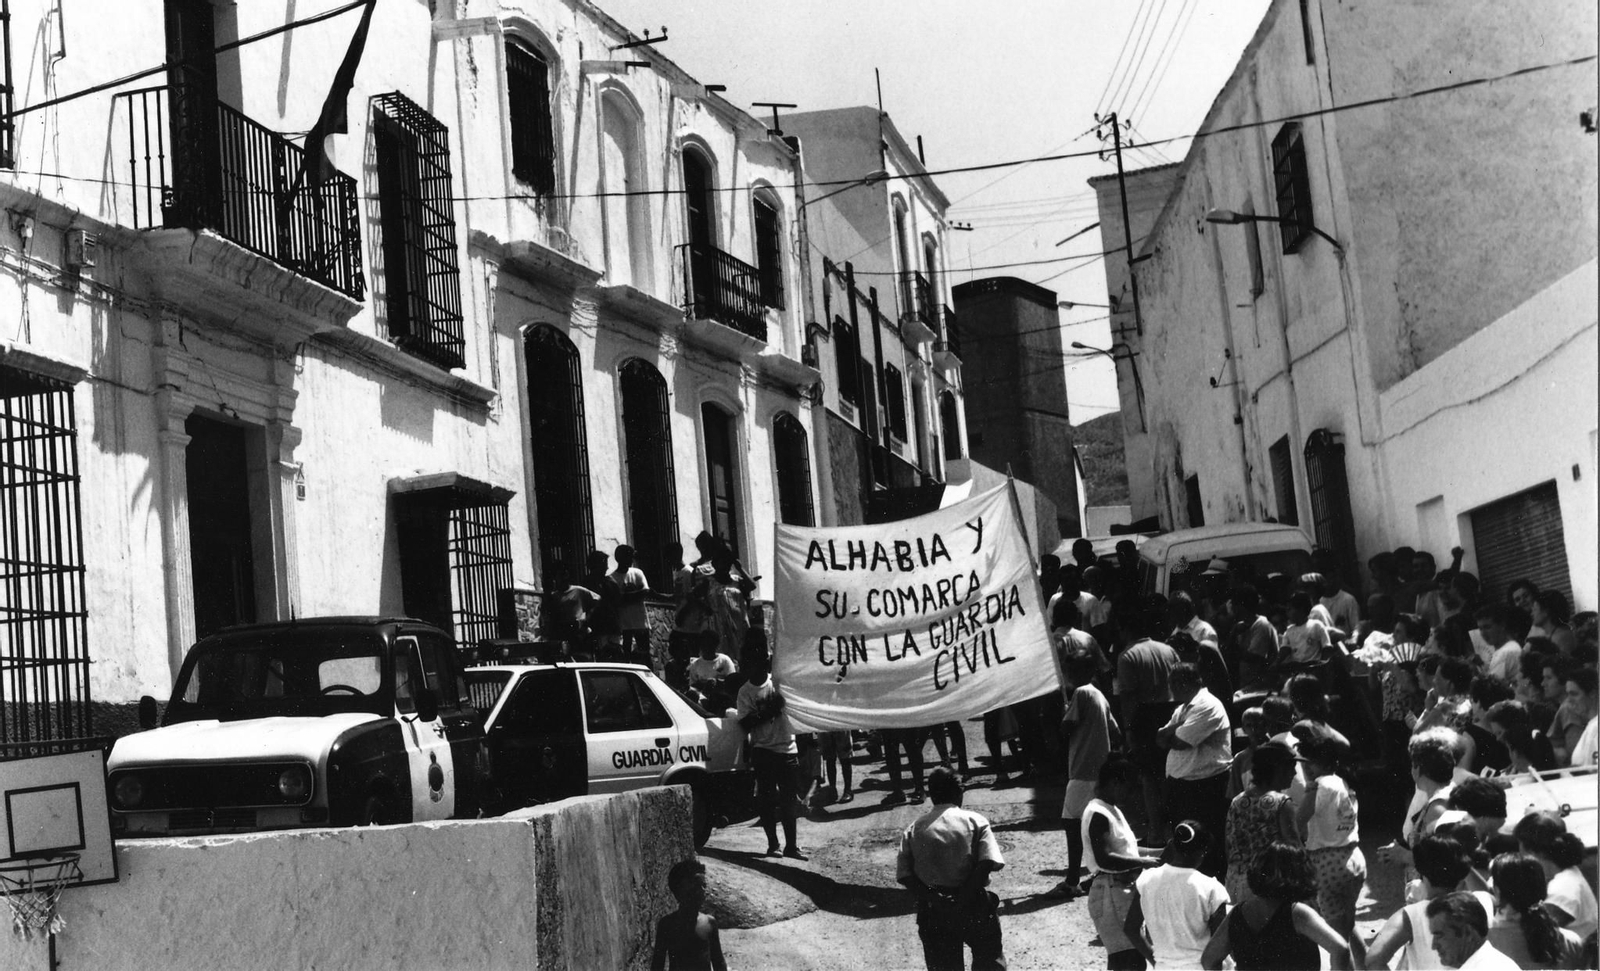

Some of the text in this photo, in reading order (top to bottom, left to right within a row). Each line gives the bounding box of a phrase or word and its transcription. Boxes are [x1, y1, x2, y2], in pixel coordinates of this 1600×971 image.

[805, 516, 983, 572] ALHABIA Y
[867, 570, 980, 617] COMARCA
[819, 585, 1025, 667] CON LA GUARDIA
[933, 628, 1016, 690] CIVIL
[612, 745, 711, 769] GUARDIA CIVIL
